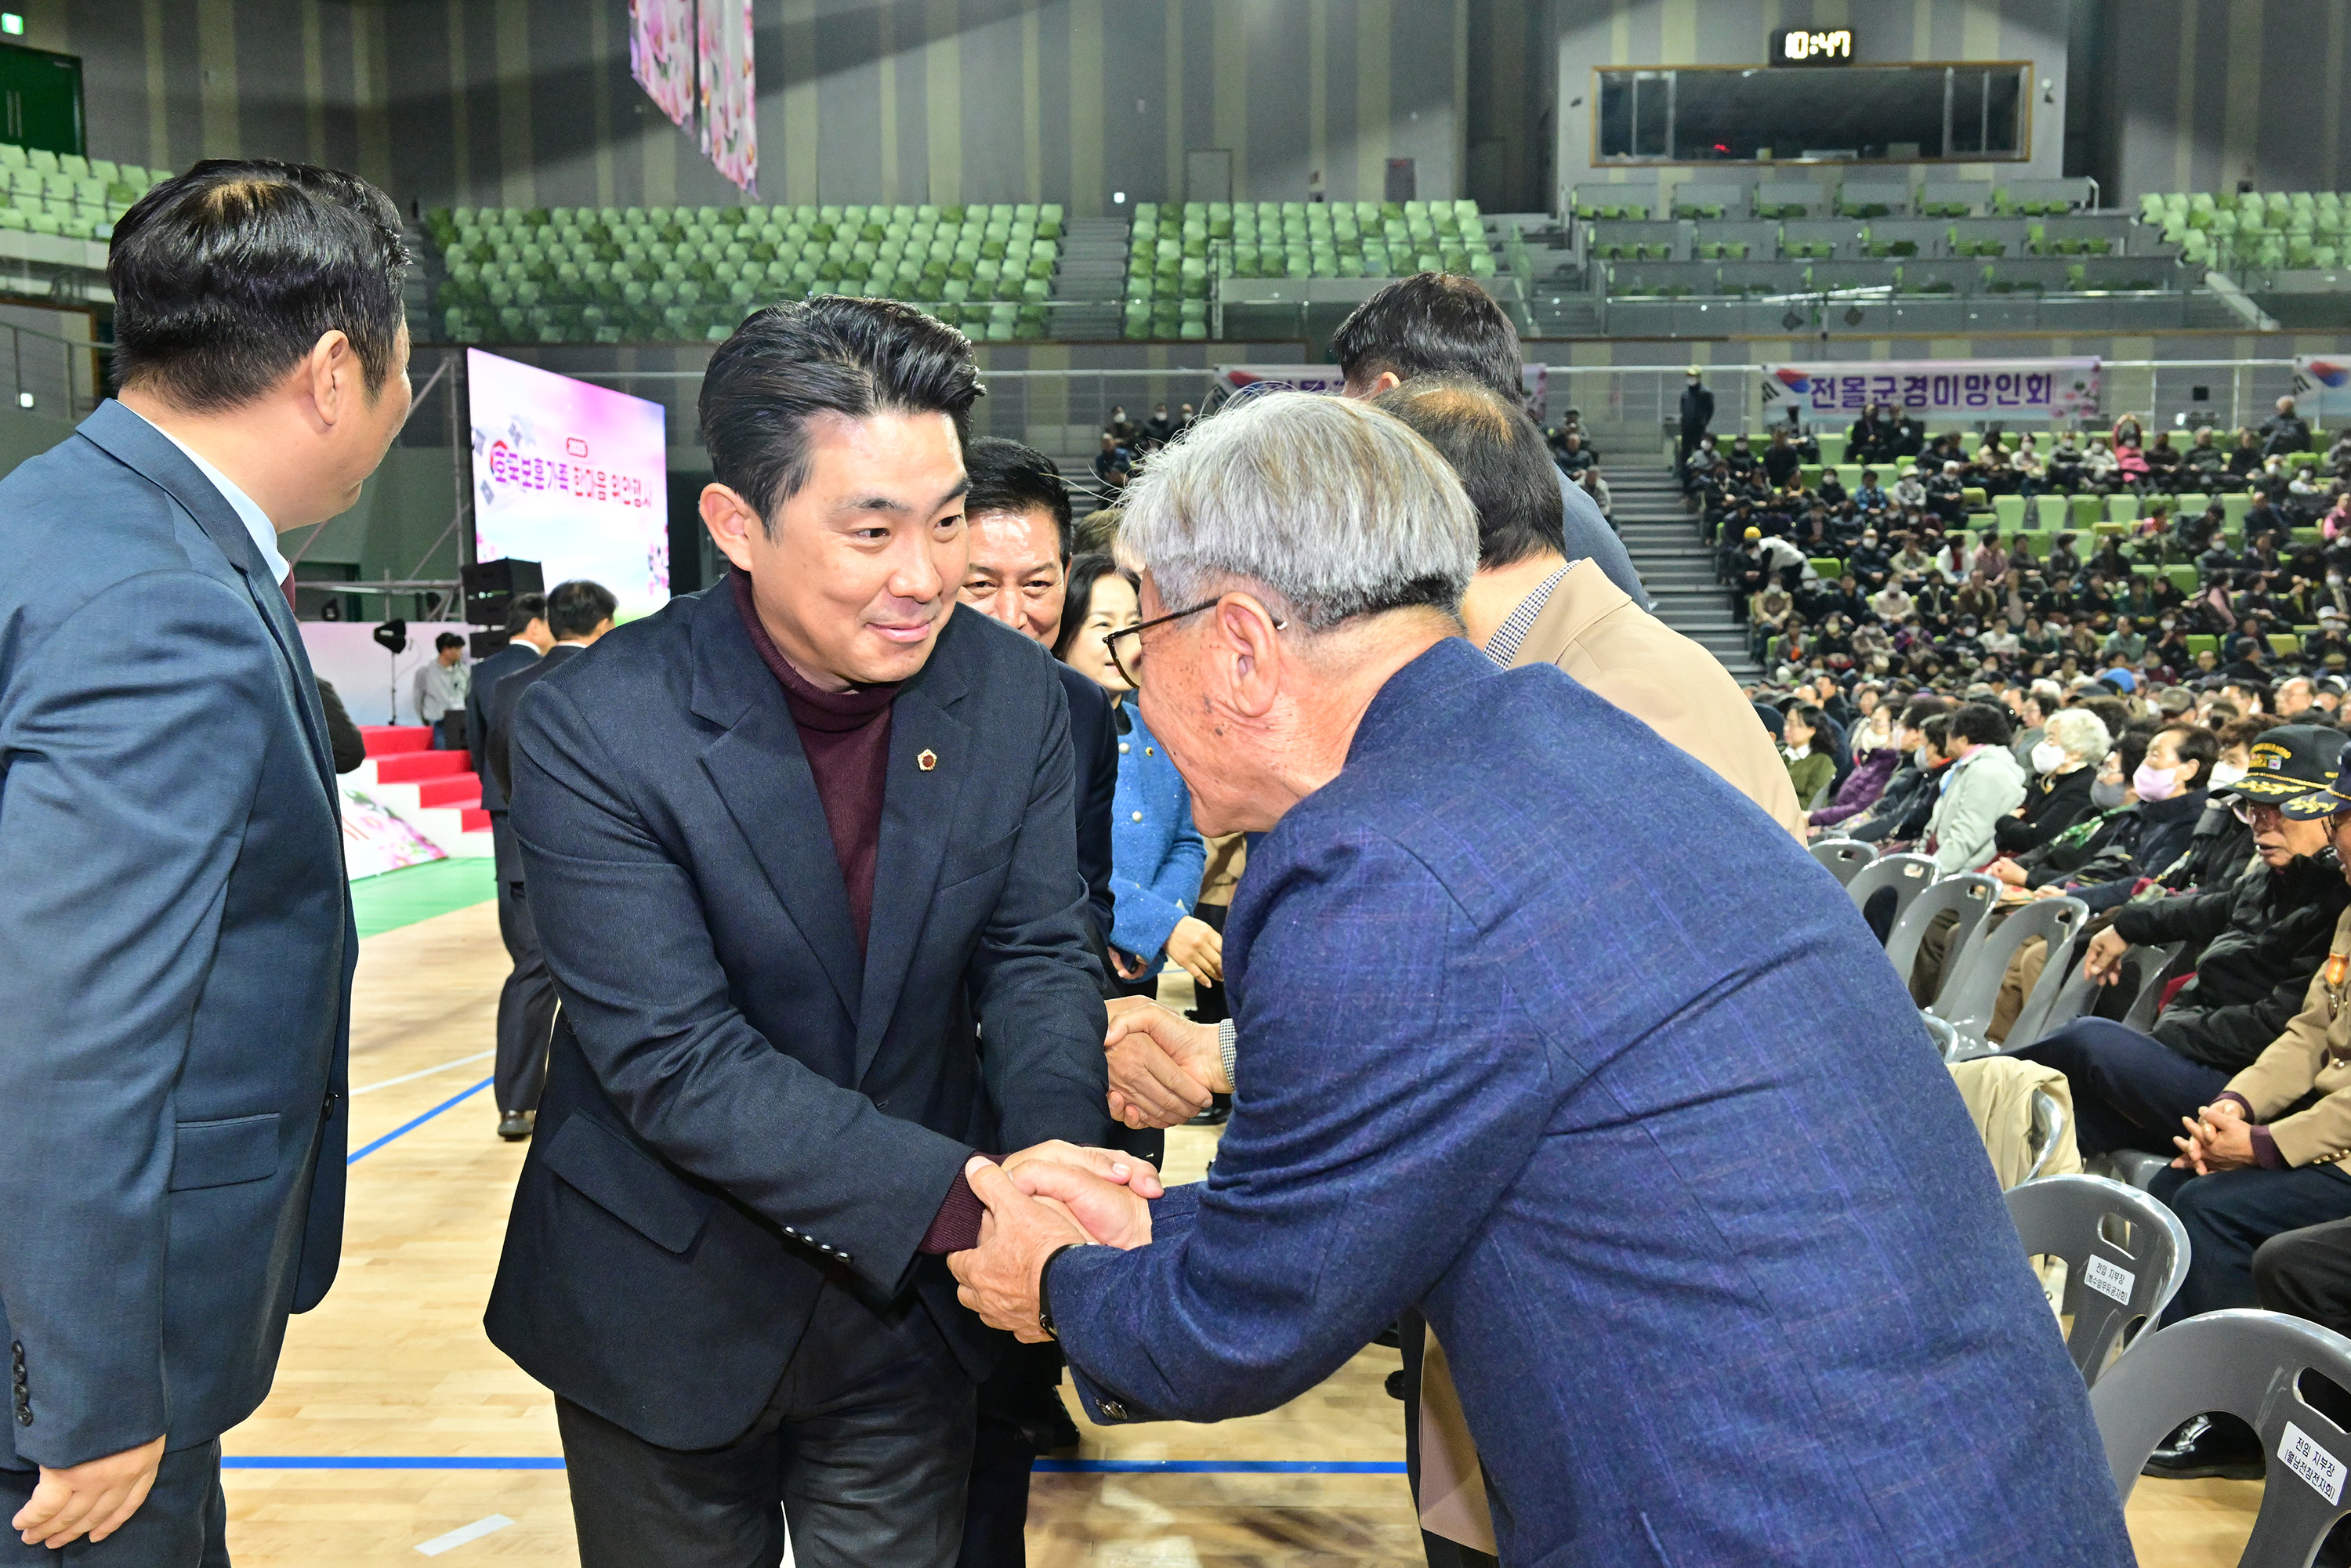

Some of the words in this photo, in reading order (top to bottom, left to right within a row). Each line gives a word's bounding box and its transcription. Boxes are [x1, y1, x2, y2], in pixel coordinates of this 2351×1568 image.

[1785, 31, 1851, 60] 10:47
[1810, 373, 2052, 409] 전몰군경미망인회
[494, 451, 569, 493] 호국보훈가족
[573, 466, 607, 502] 한마음
[2096, 1262, 2108, 1276] 전임
[2108, 1269, 2125, 1285] 지부장
[2295, 1436, 2312, 1458] 전임
[2312, 1450, 2335, 1478] 지부장
